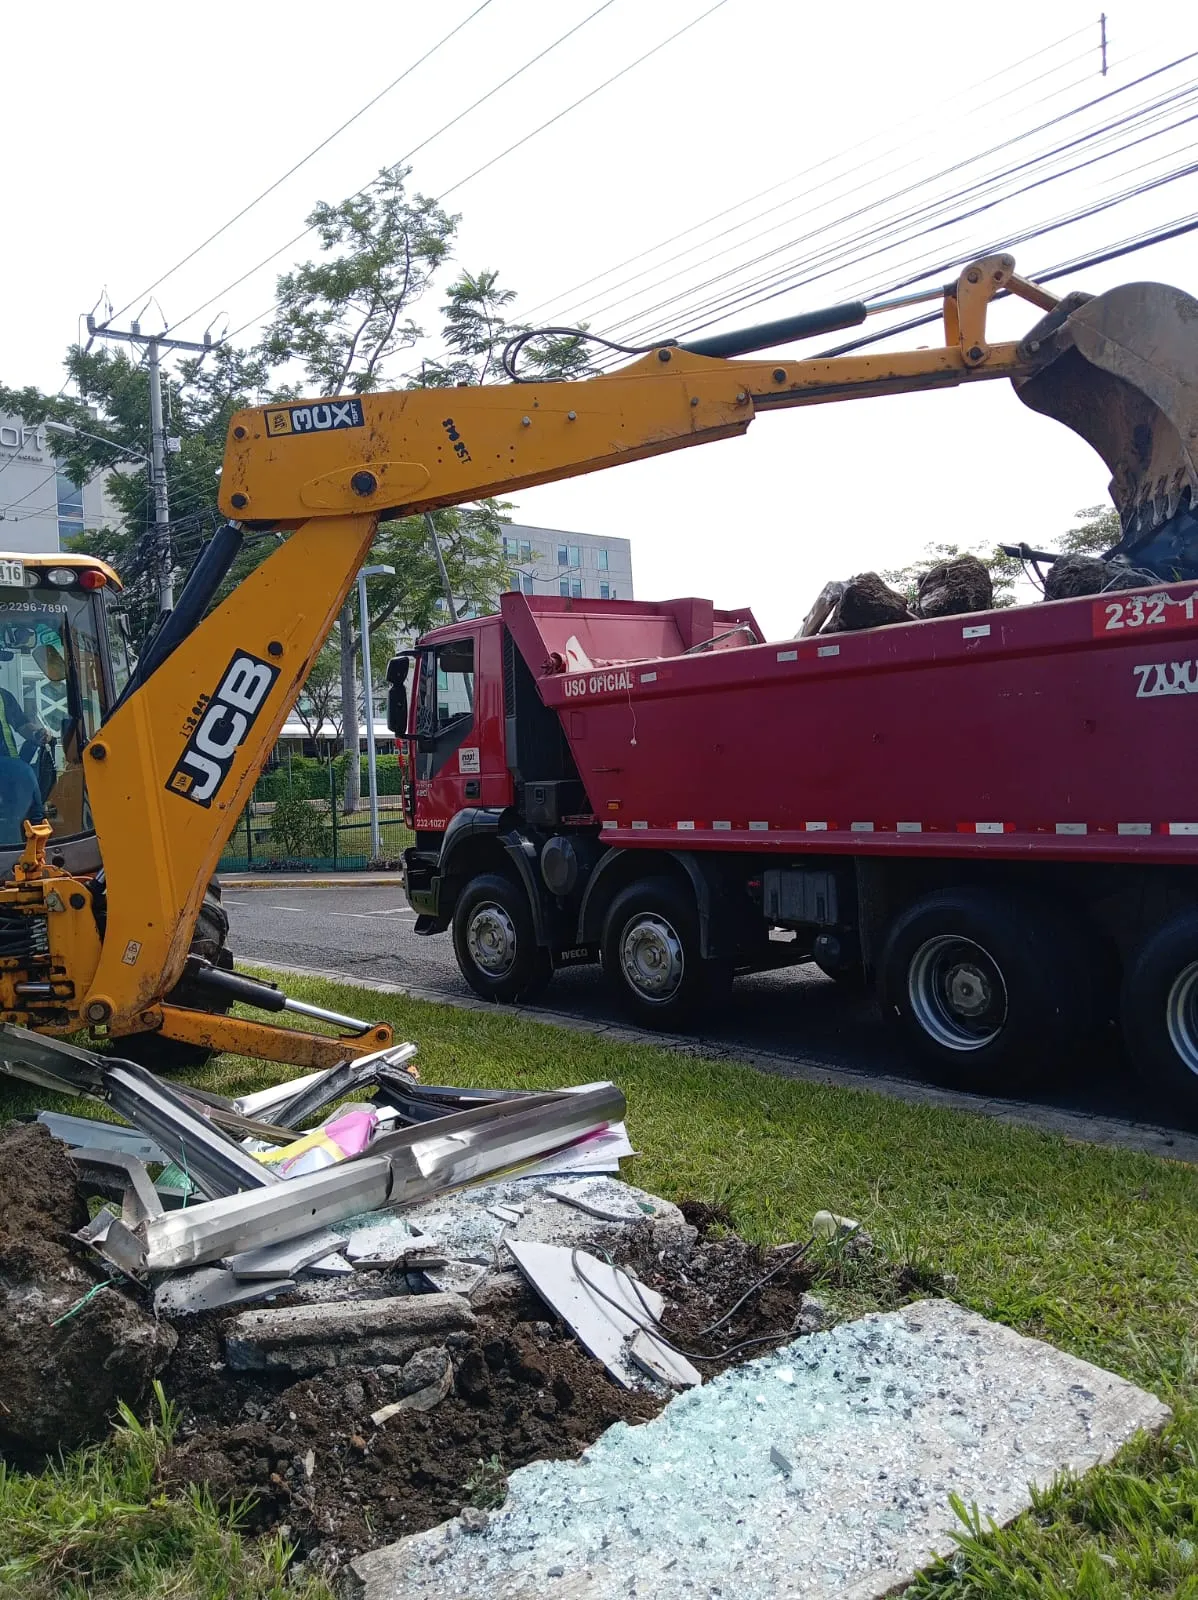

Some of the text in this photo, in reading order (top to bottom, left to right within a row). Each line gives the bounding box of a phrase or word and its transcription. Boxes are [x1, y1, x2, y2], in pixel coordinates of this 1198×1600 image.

[9, 602, 68, 613] 2296-7890
[1105, 596, 1166, 630] 232
[564, 671, 634, 697] USO OFICIAL
[183, 657, 273, 800] JCB
